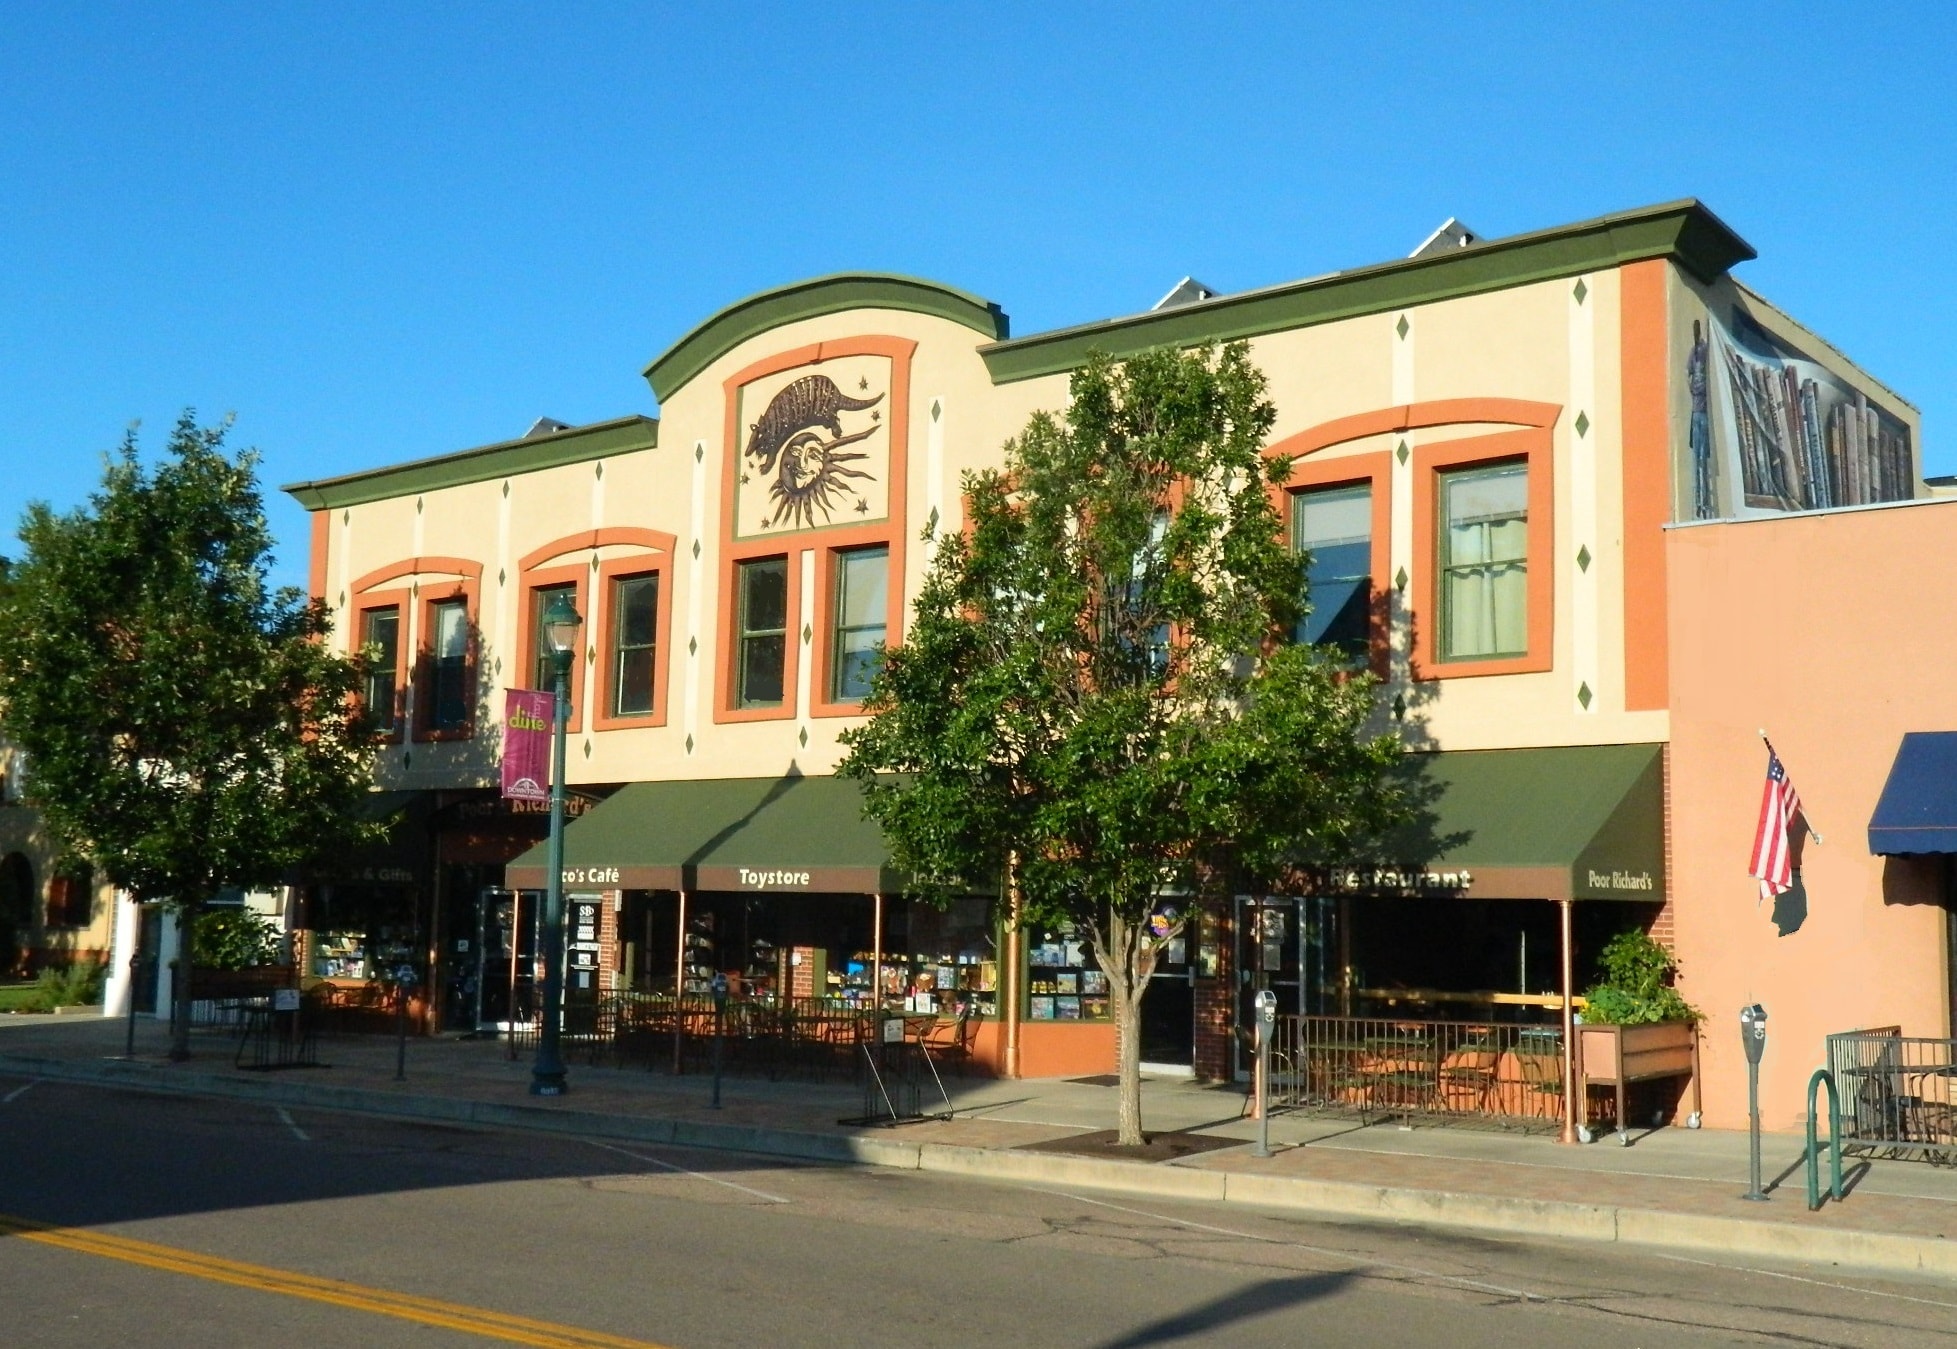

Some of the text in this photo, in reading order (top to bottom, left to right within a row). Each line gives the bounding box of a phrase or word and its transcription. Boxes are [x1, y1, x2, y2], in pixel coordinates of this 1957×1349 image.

[508, 704, 546, 731] dine
[507, 786, 545, 796] DOWNTOWN
[588, 867, 620, 883] Café
[739, 868, 810, 889] Toystore
[1330, 868, 1471, 889] Restaurant
[1588, 869, 1653, 890] Poor Richard's
